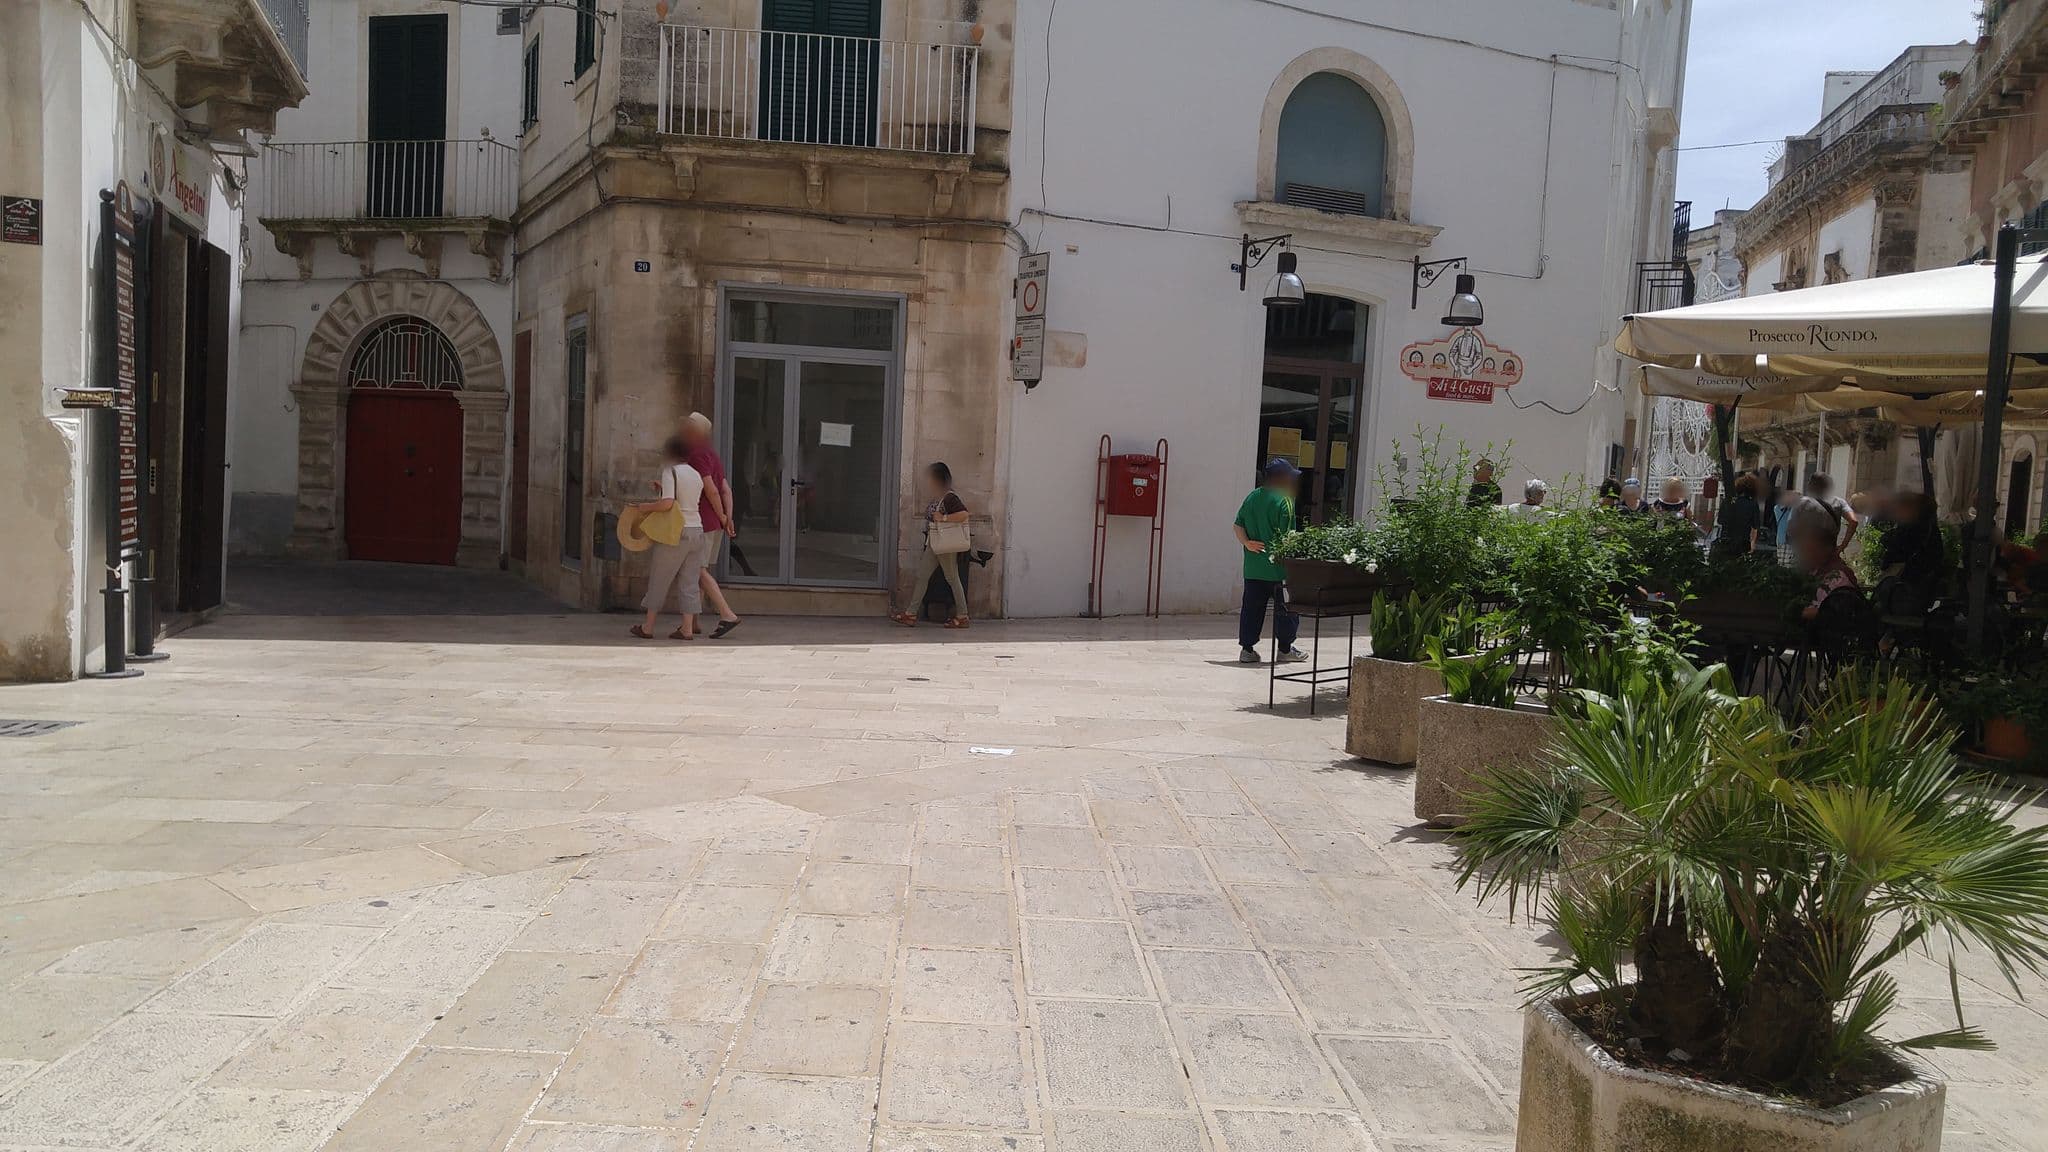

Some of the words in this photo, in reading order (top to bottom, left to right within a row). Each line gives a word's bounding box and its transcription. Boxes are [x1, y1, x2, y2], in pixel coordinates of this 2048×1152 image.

[168, 148, 205, 217] Angelini
[637, 262, 648, 272] 20
[1749, 328, 1805, 343] Prosecco
[1430, 378, 1449, 392] Ai
[1450, 380, 1458, 393] 4
[1459, 380, 1492, 396] Gusti
[1696, 375, 1738, 386] Prosecco
